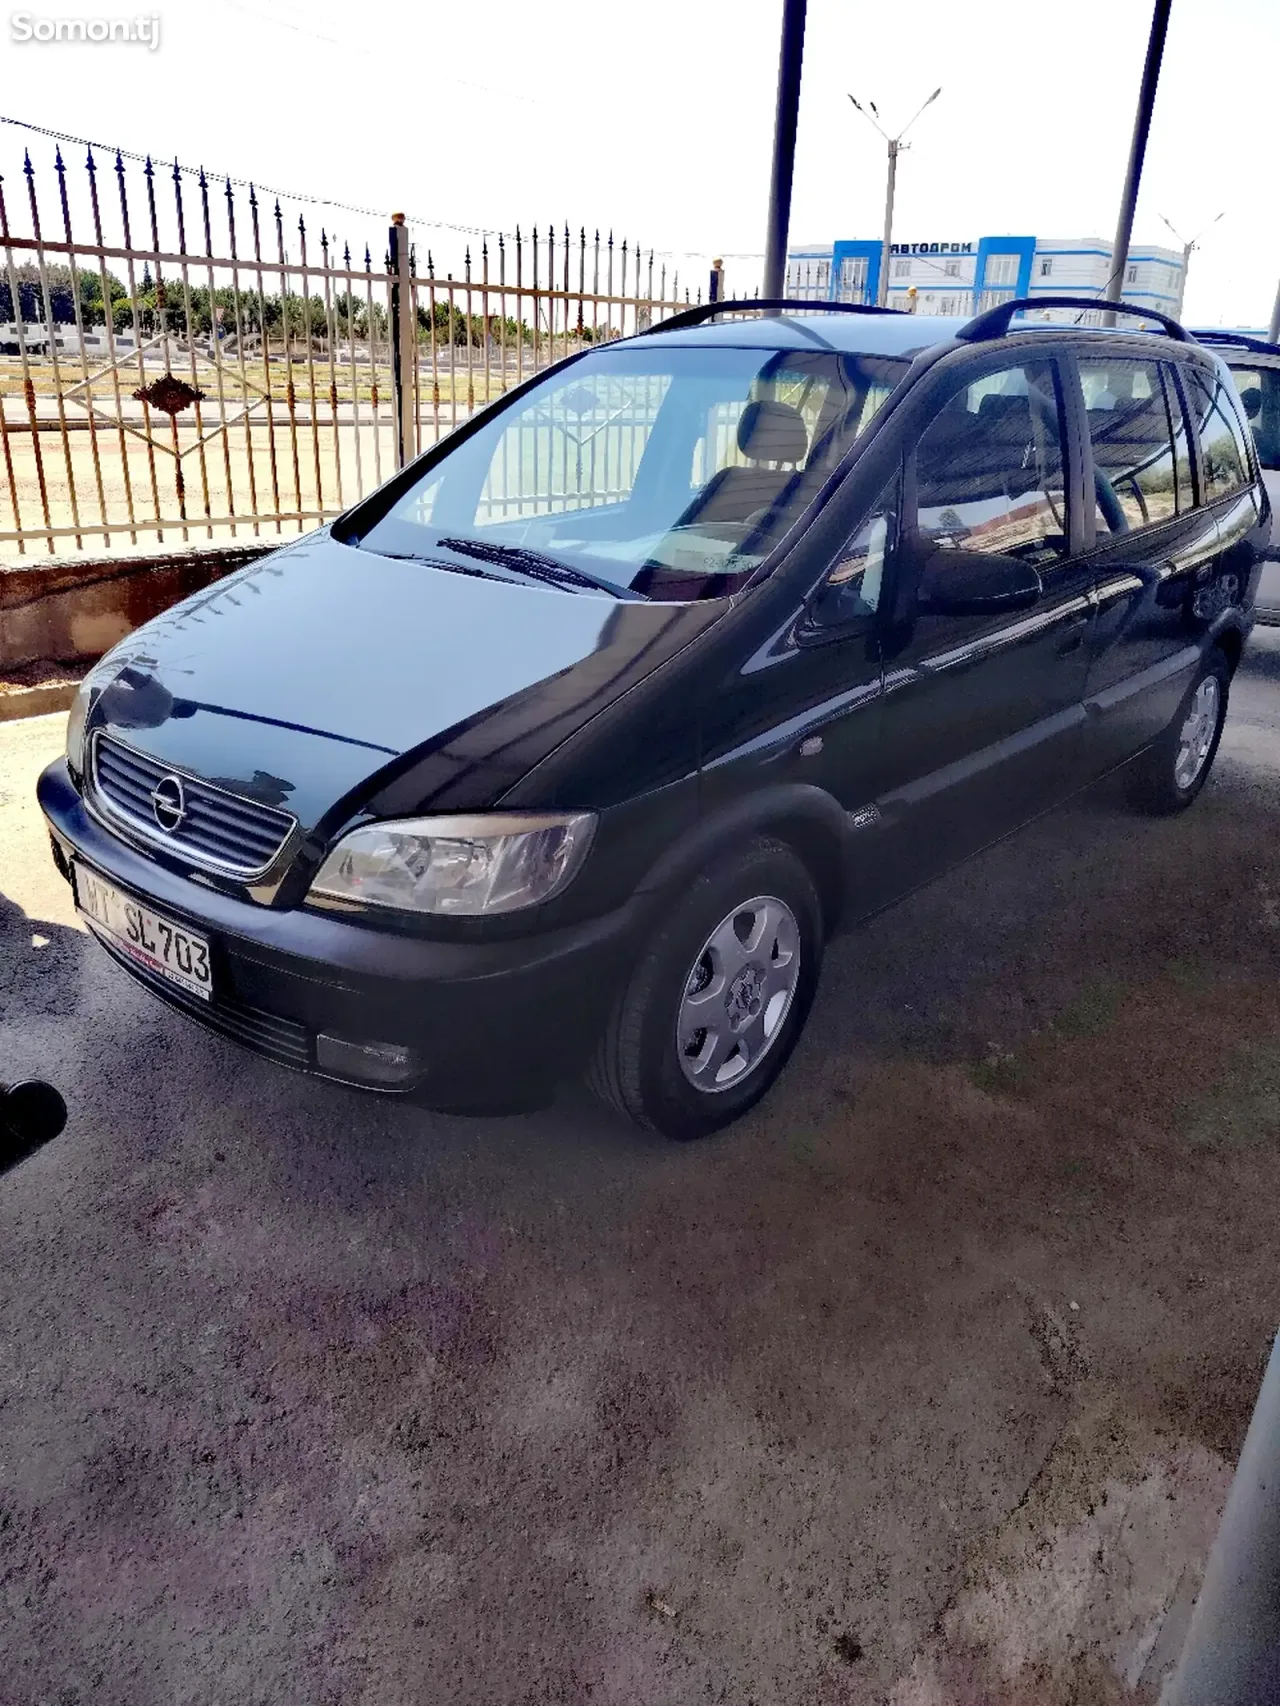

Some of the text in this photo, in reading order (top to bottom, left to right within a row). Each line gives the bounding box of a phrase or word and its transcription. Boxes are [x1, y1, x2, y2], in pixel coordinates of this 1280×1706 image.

[890, 242, 972, 254] АВТОДРОМ
[124, 902, 156, 954] SL
[157, 921, 210, 983] 703
